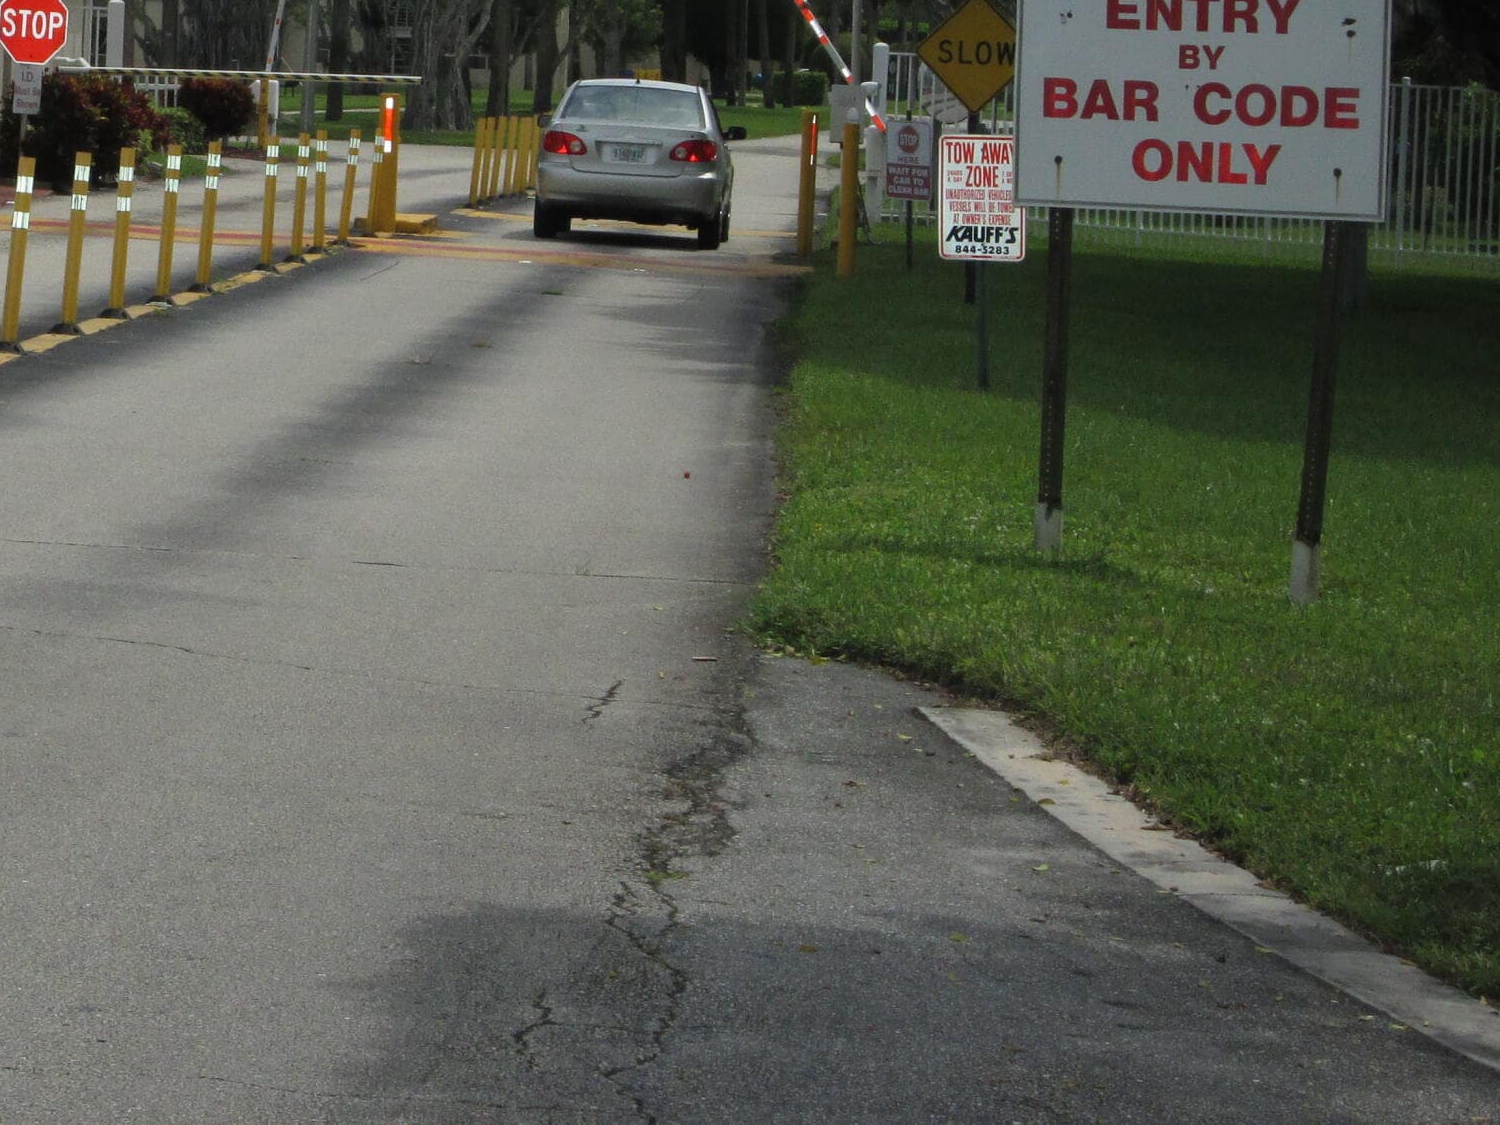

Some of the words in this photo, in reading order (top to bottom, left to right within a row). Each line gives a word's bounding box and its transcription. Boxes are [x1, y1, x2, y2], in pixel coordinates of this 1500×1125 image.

[2, 7, 64, 40] STOP
[938, 39, 1016, 66] SLOW
[1178, 44, 1225, 70] BY
[1042, 77, 1160, 122] BAR
[1193, 81, 1360, 129] CODE
[900, 134, 918, 146] STOP
[946, 141, 975, 164] TOW
[1131, 138, 1283, 186] ONLY
[888, 166, 910, 175] WAIT
[965, 165, 999, 188] ZONE
[946, 189, 986, 200] UNAUTHORIZED
[949, 201, 972, 213] VESSELS
[974, 201, 986, 213] WILL
[989, 214, 1011, 225] EXPENSE
[945, 226, 1019, 244] KAUFF'S
